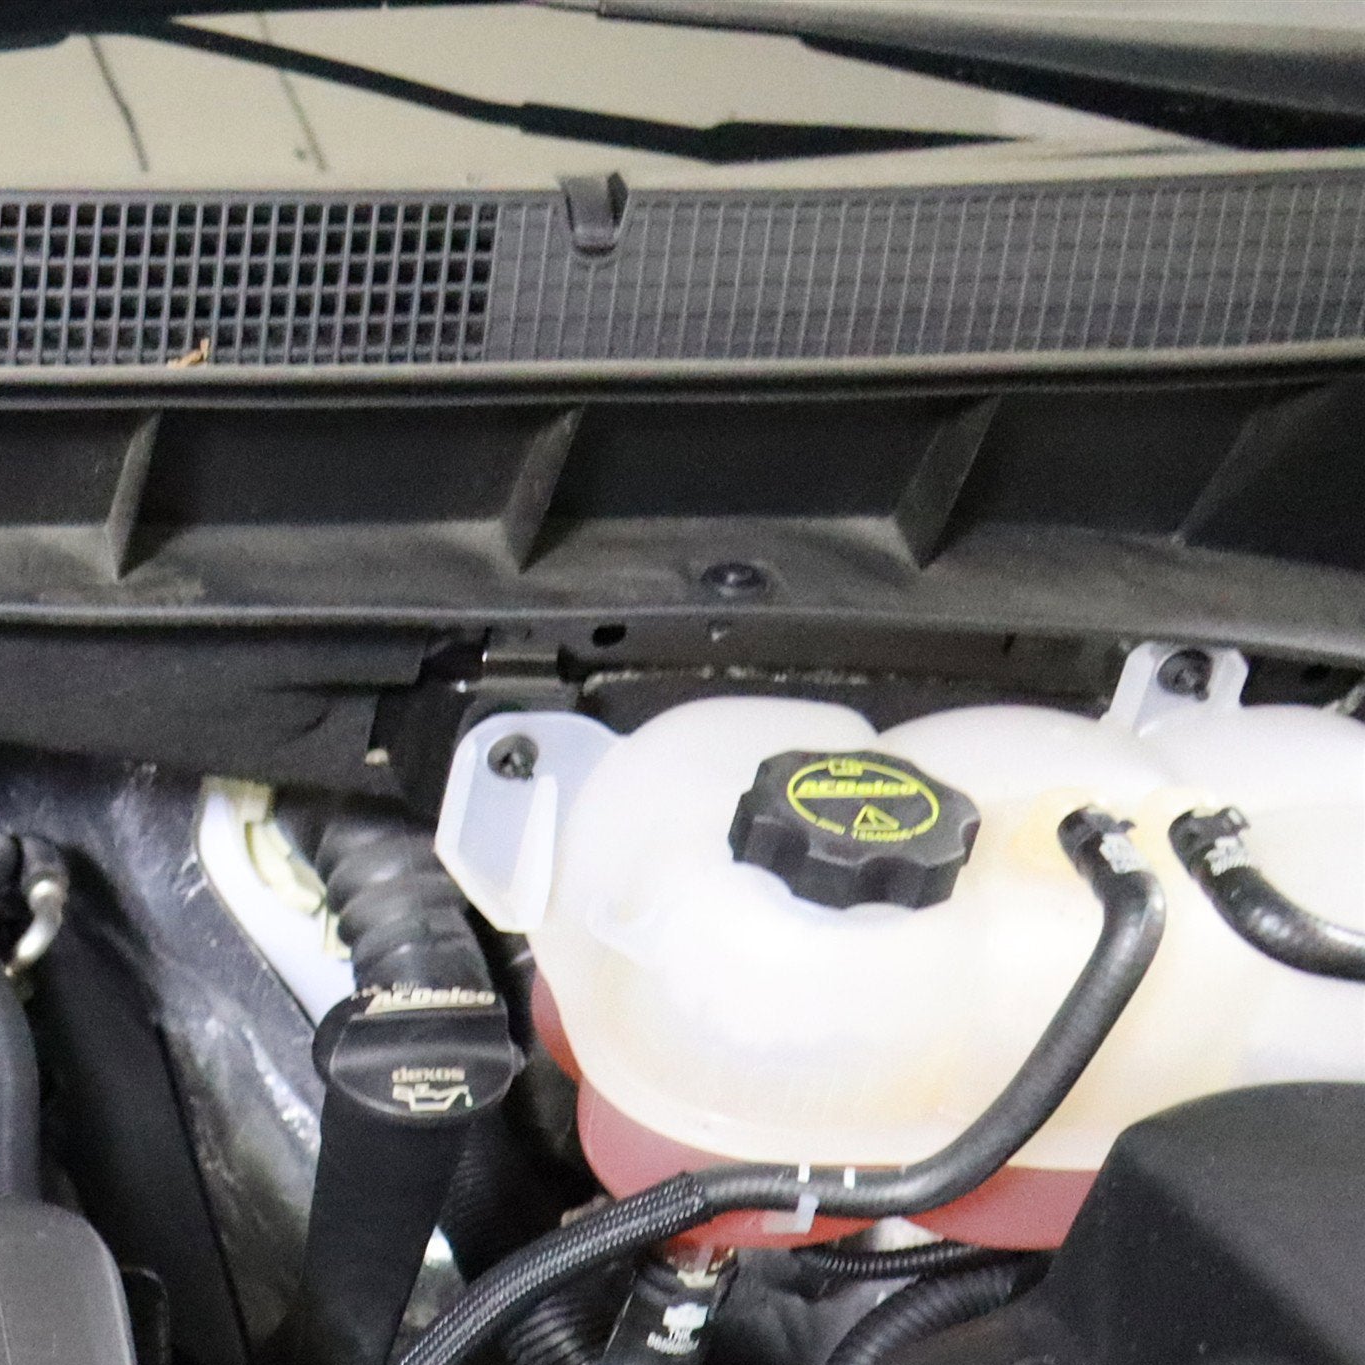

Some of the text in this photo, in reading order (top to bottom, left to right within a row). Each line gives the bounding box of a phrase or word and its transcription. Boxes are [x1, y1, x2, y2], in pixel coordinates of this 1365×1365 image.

[795, 779, 920, 799] ACDelco
[365, 986, 496, 1015] ACDelco
[391, 1066, 466, 1083] dexos
